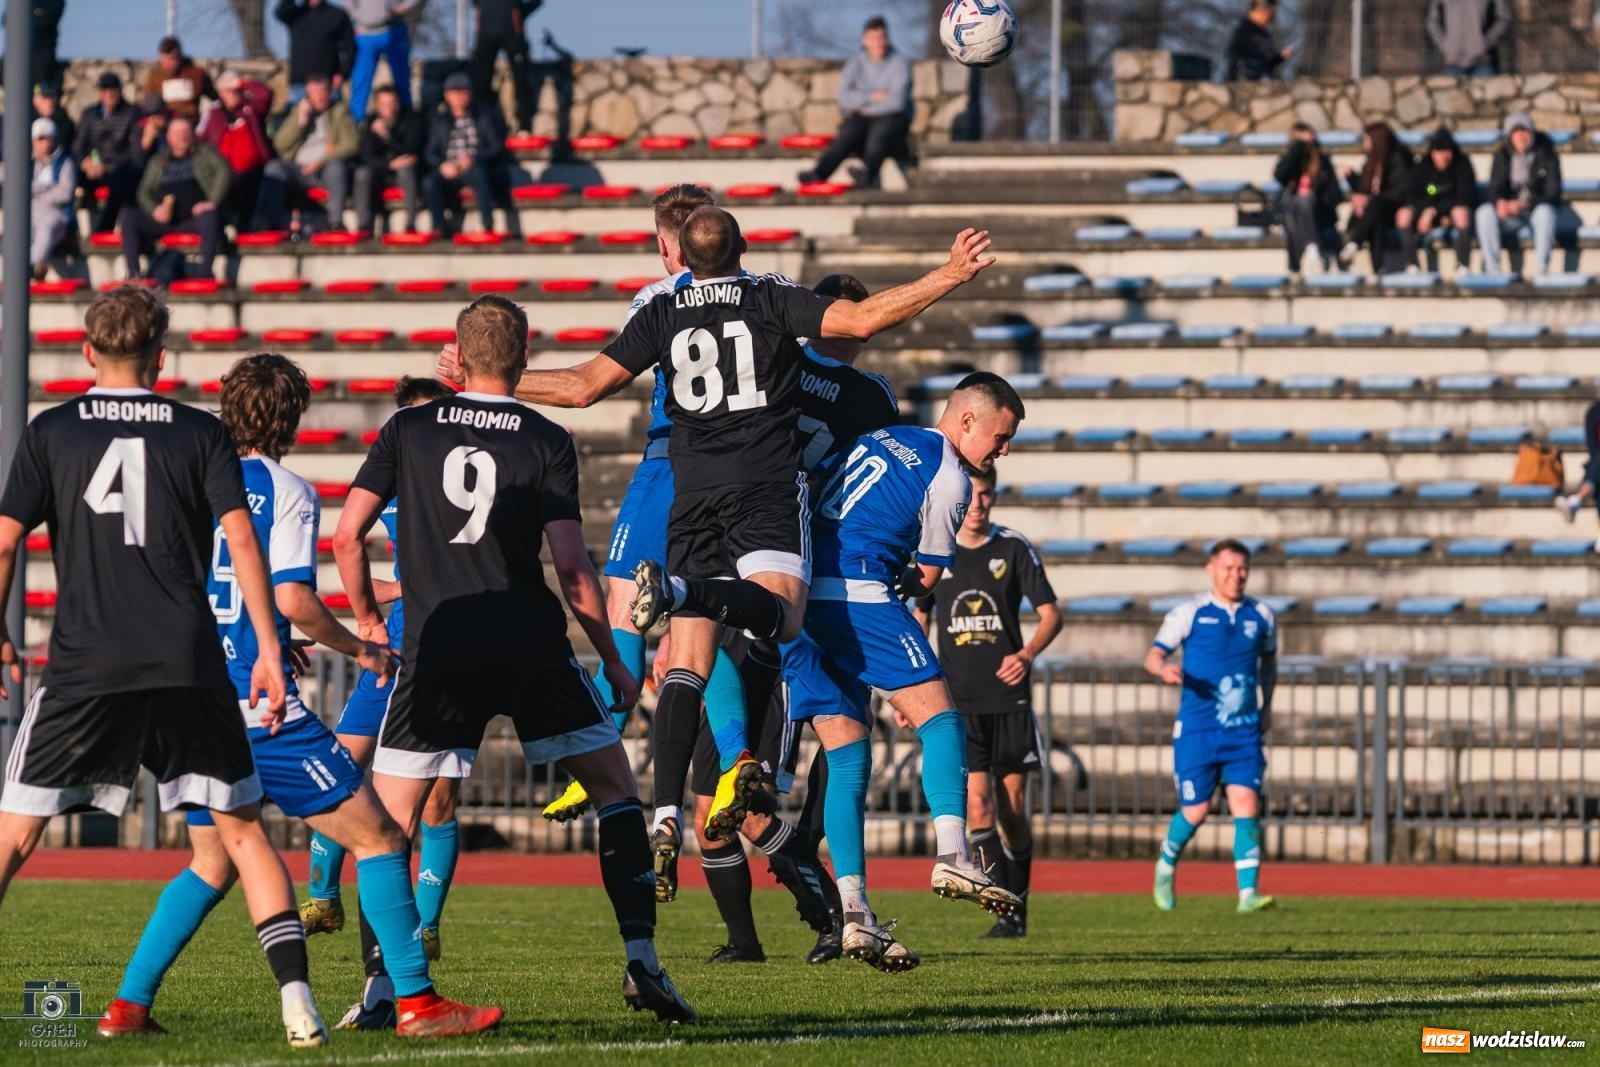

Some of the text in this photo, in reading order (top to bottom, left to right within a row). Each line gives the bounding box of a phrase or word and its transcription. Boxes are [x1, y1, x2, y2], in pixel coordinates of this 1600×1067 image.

[675, 283, 742, 309] LUBOMIA
[670, 320, 767, 413] 81
[78, 400, 173, 423] LUBOMIA
[436, 406, 522, 431] LUBOMIA
[82, 437, 146, 547] 4
[442, 445, 497, 545] 9
[814, 444, 888, 520] 10
[947, 615, 1004, 633] JANETA
